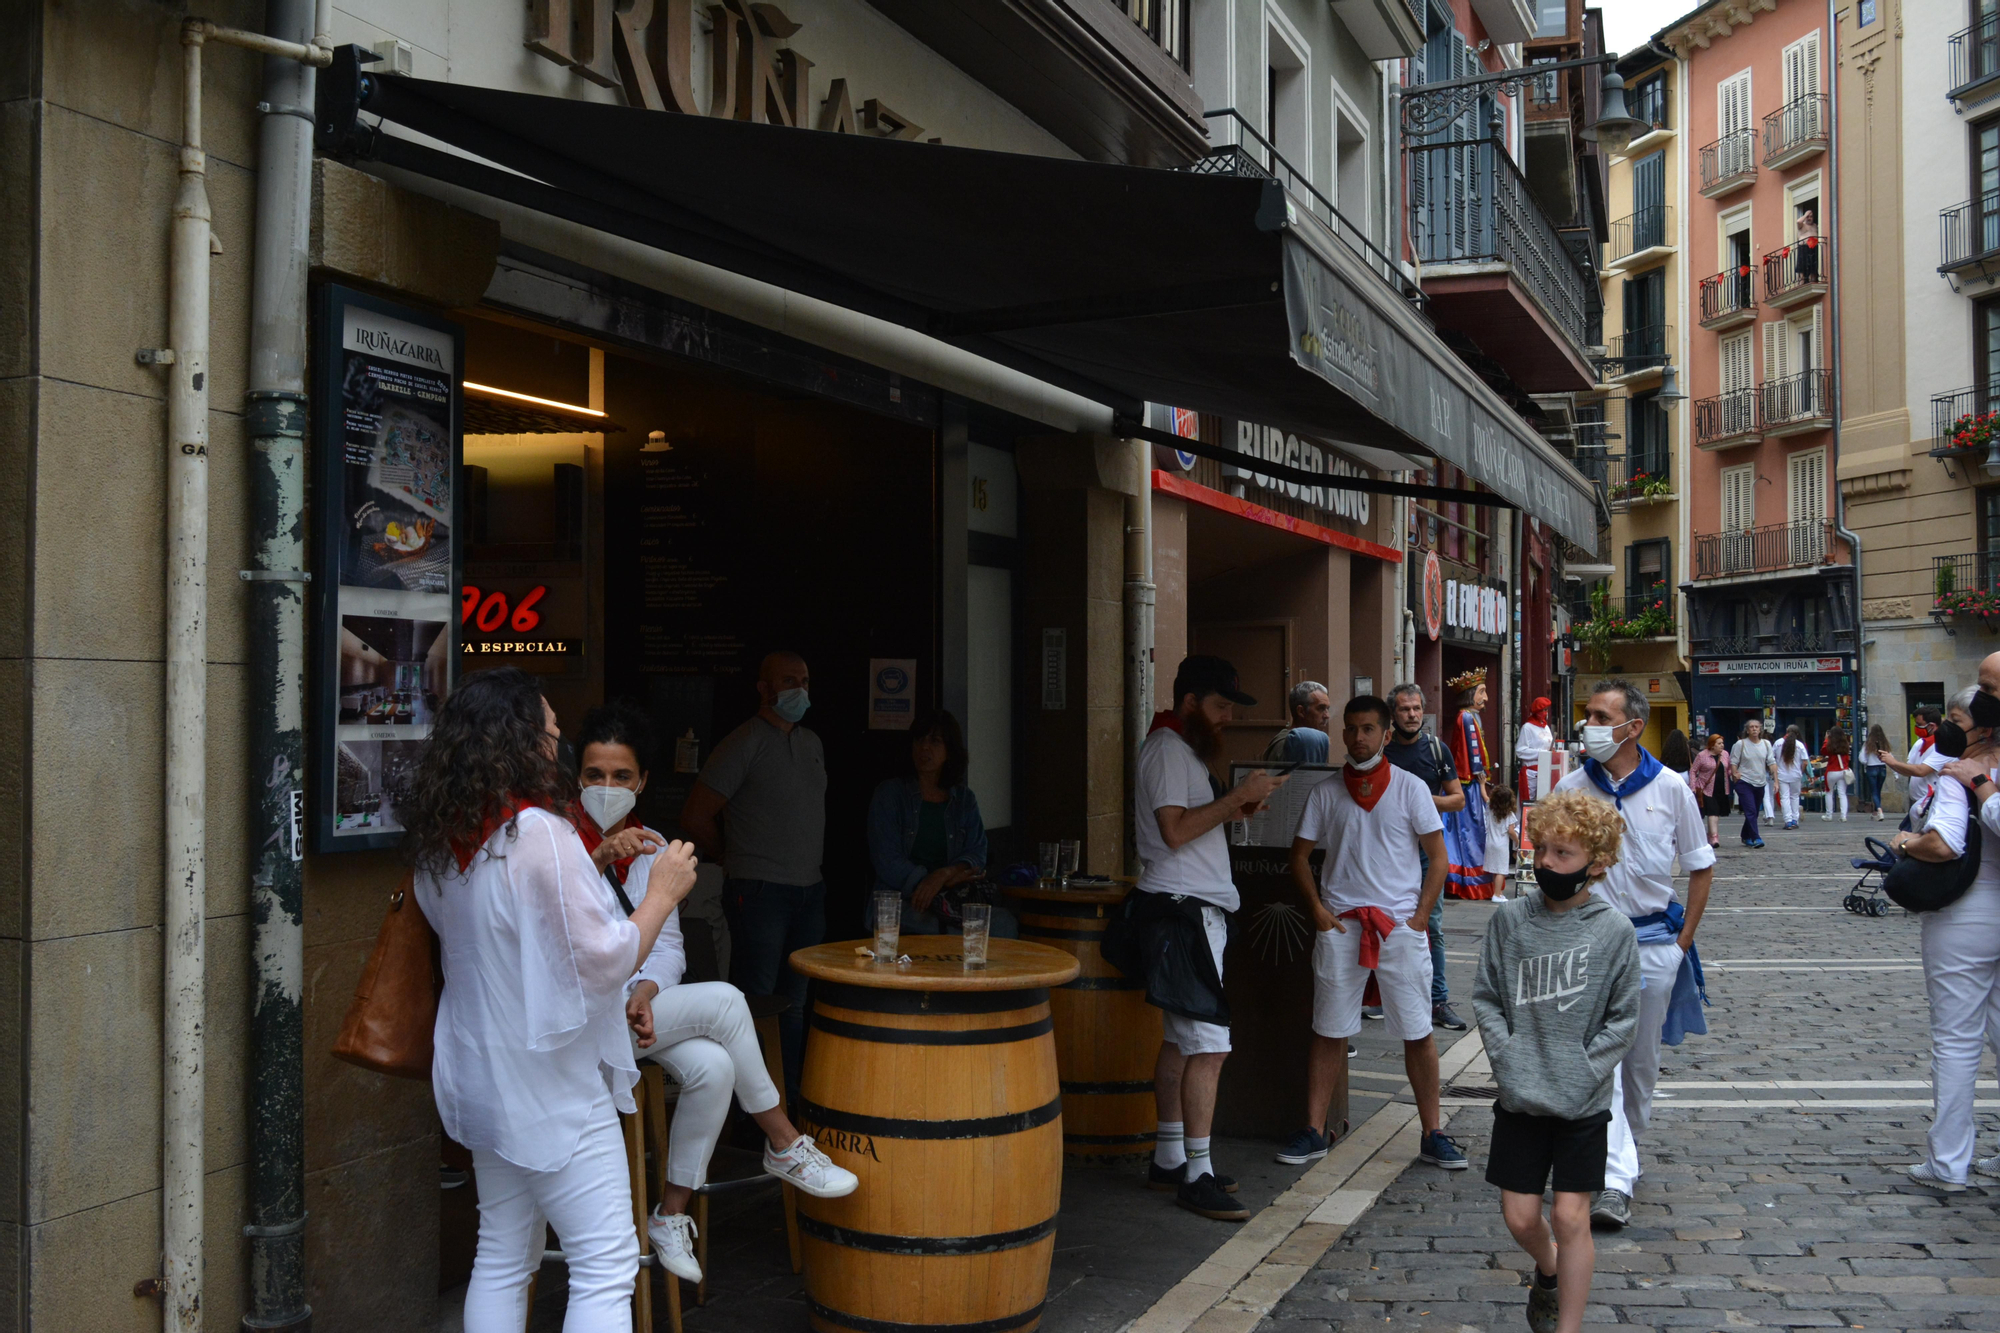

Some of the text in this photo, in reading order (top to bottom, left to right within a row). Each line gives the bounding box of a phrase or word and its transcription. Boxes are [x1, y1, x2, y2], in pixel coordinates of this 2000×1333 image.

[356, 328, 444, 370] IRUÑAZARRA
[1430, 386, 1452, 440] BAR
[181, 444, 208, 456] GA
[1238, 420, 1370, 526] BURGER KING
[972, 475, 987, 512] 15
[461, 642, 567, 653] A ESPECIAL
[1726, 661, 1781, 671] ALIMENTACION
[1783, 660, 1809, 670] IRUÑA
[1516, 944, 1590, 1006] NIKE
